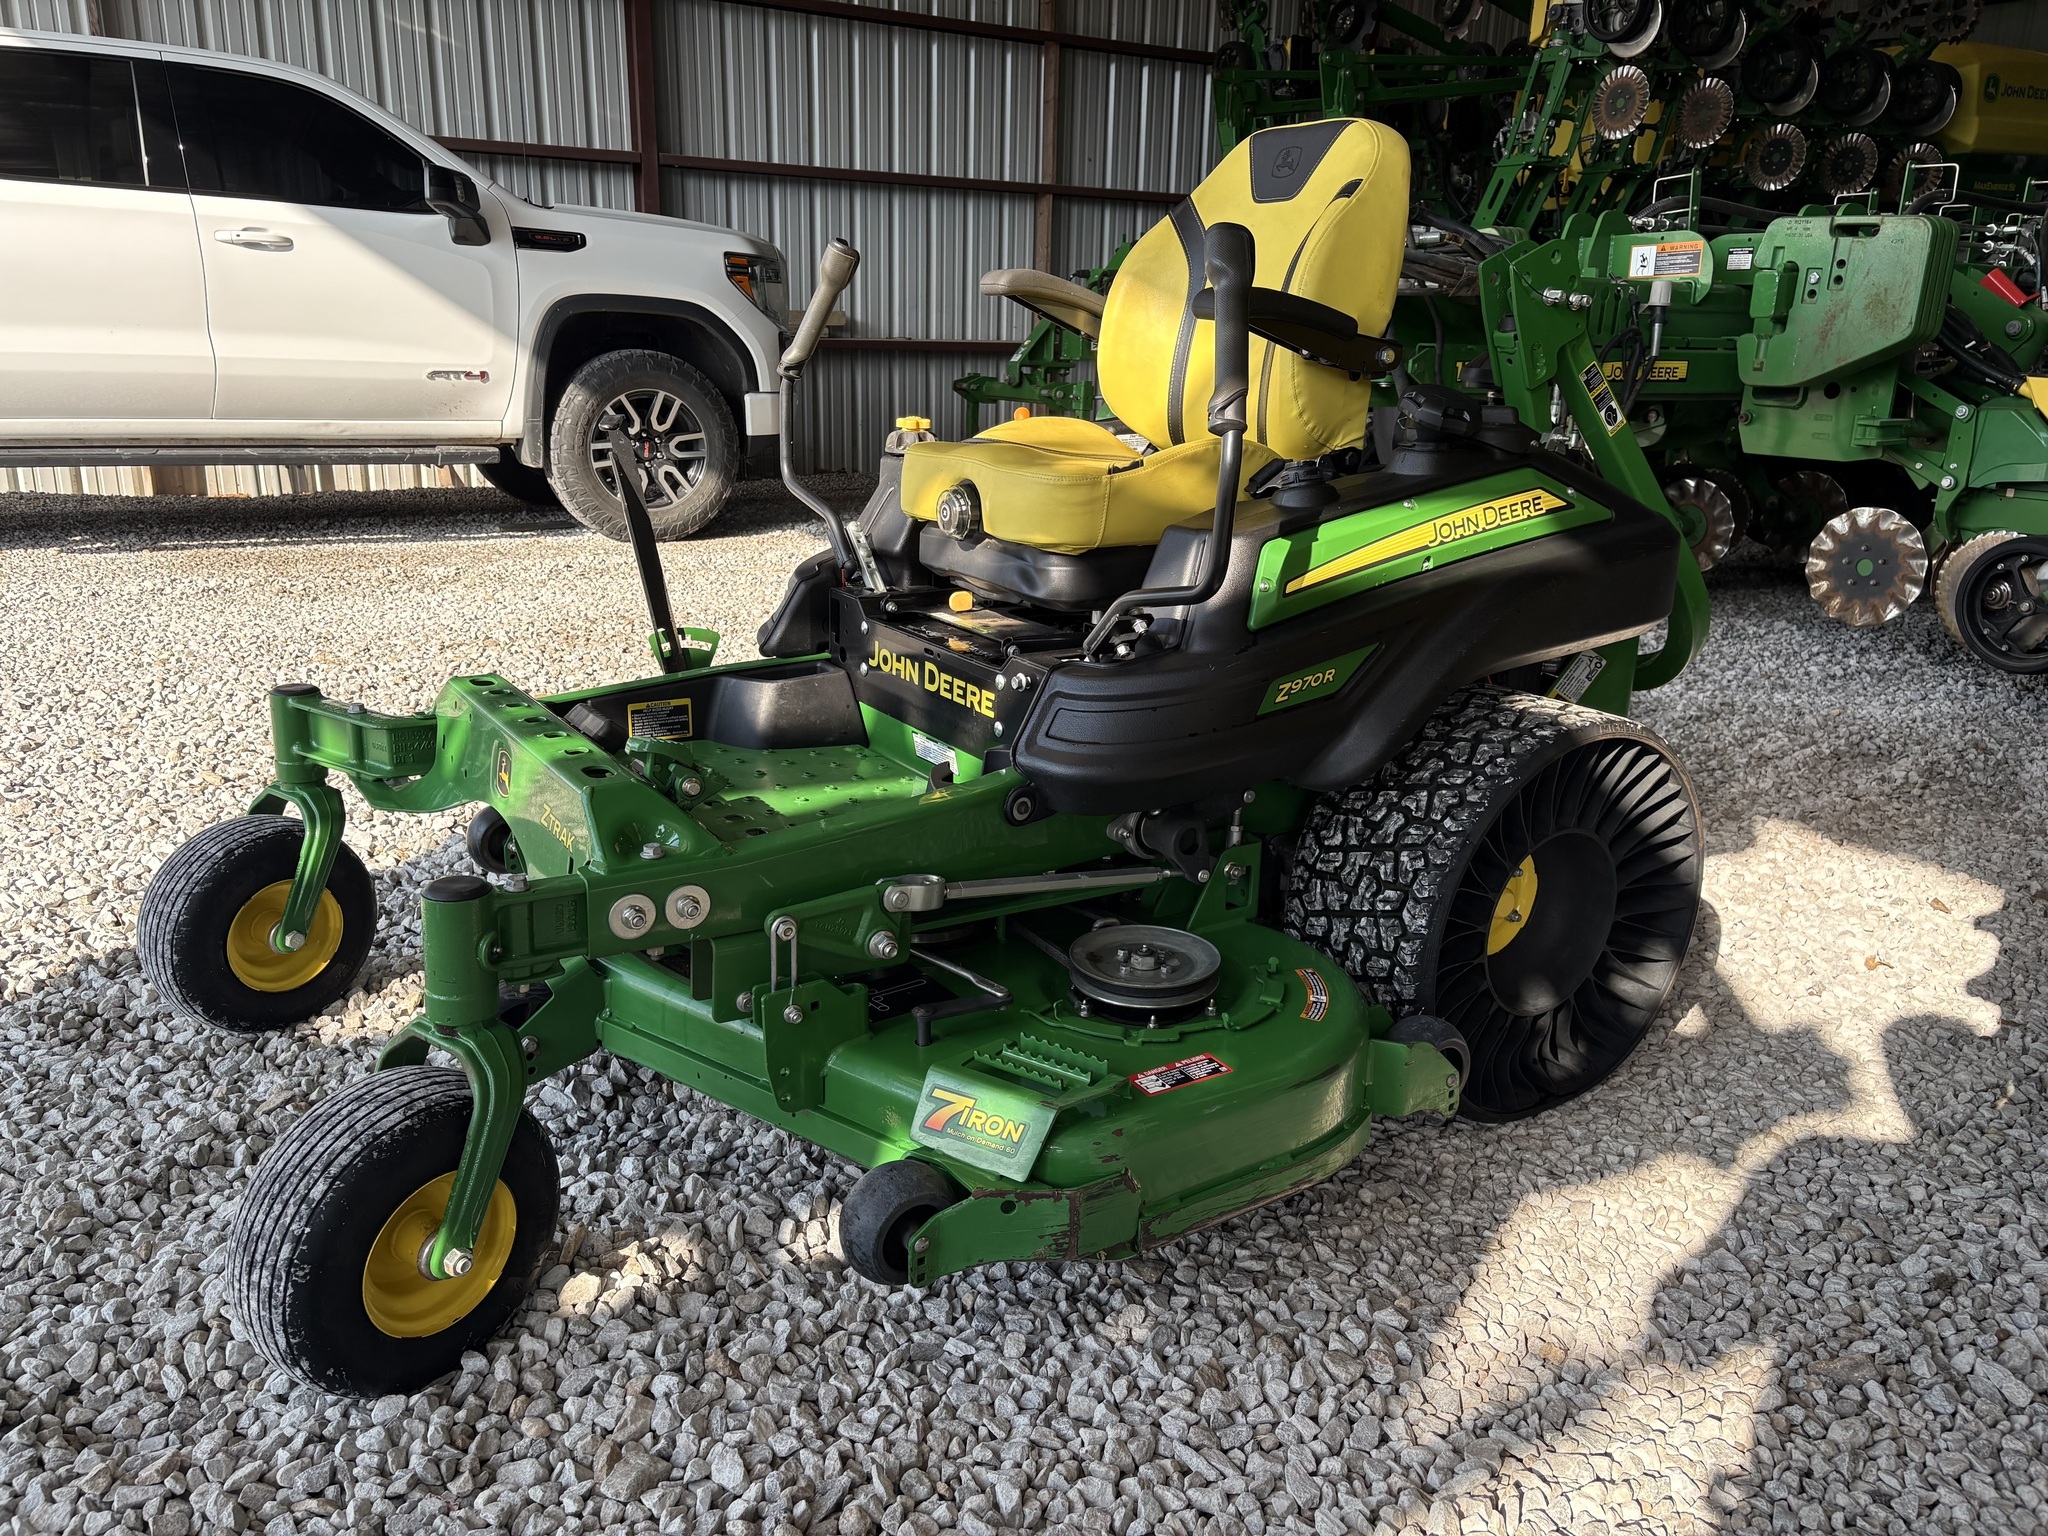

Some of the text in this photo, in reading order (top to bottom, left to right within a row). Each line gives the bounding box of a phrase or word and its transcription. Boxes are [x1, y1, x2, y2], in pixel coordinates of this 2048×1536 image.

[2000, 83, 2026, 98] JOHN
[1648, 366, 1679, 378] EERE
[1428, 496, 1544, 545] JOHN DEERE
[868, 640, 995, 718] JOHN DEERE
[1275, 668, 1336, 703] Z970R
[540, 802, 576, 854] ZTRAK
[1143, 1066, 1168, 1077] DANGER
[1181, 1054, 1206, 1065] PELIGRO
[947, 1128, 966, 1139] Mulch
[976, 1137, 1004, 1151] Demand
[1006, 1146, 1016, 1154] 60
